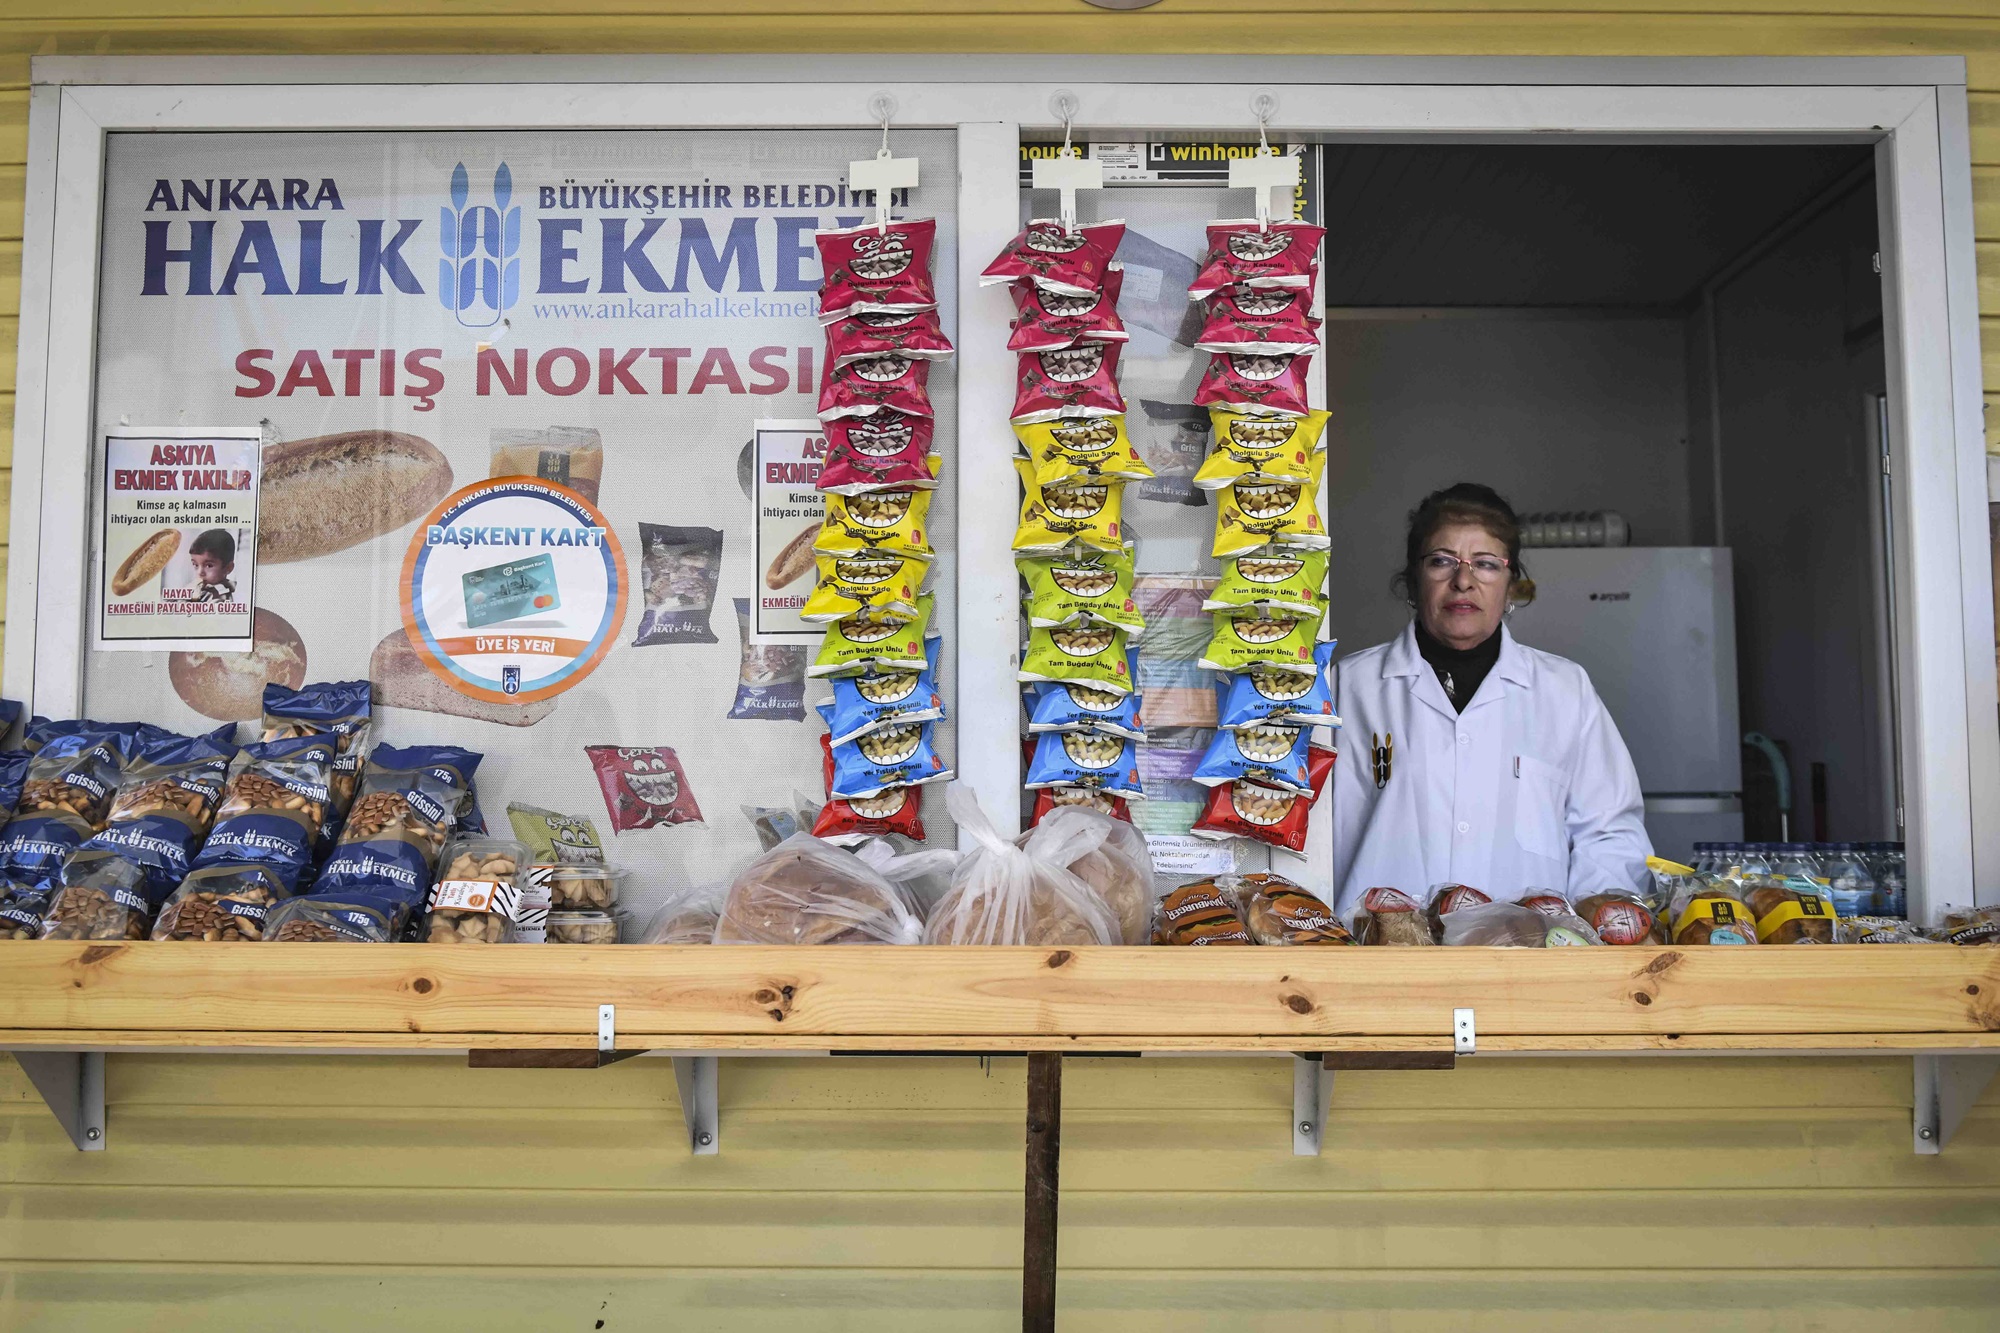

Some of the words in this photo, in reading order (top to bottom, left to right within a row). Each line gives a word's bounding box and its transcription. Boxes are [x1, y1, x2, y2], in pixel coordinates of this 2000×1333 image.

[145, 178, 345, 212] ANKARA
[538, 177, 736, 215] BÜYÜKŞEHİR
[140, 219, 426, 296] HALK
[536, 216, 904, 294] EKME
[234, 348, 445, 413] SATIŞ
[476, 346, 813, 397] NOKTASI
[150, 445, 215, 465] ASKIYA
[115, 470, 178, 490] EKMEK
[182, 470, 251, 490] TAKILIR
[442, 506, 457, 519] T.C.
[457, 489, 492, 508] ANKARA
[789, 493, 818, 503] Kimse
[137, 501, 165, 510] Kimse
[168, 503, 179, 512] aç
[183, 500, 226, 510] kalmasın
[763, 508, 800, 519] ihtiyacı
[803, 508, 824, 517] olan
[111, 514, 147, 525] ihtiyacı
[150, 515, 170, 524] olan
[174, 514, 212, 524] askıdan
[215, 514, 238, 524] alsın
[1079, 522, 1097, 530] Sade
[1247, 520, 1275, 529] Dolgulu
[428, 526, 535, 549] BAŞKENT
[541, 528, 604, 547] KART
[850, 528, 878, 536] Dolgulu
[881, 530, 900, 538] Sade
[163, 589, 193, 599] HAYAT
[108, 602, 155, 614] EKMEĞİNİ
[158, 603, 214, 617] PAYLAŞINCA
[218, 602, 248, 614] GÜZEL
[1103, 602, 1120, 610] Unlu
[476, 636, 503, 651] ÜYE
[507, 636, 519, 653] İŞ
[524, 639, 555, 653] YERİ
[837, 649, 853, 657] Tam
[856, 646, 883, 654] Buğday
[1096, 661, 1112, 671] Unlu
[862, 709, 873, 717] Yer
[875, 705, 896, 715] Fıstığı
[897, 701, 921, 711] Çeşnili
[1289, 702, 1312, 710] Çeşnili
[1101, 714, 1124, 722] Çeşnili
[94, 747, 110, 763] 175g
[306, 750, 324, 761] 175g
[434, 769, 452, 783] 175g
[876, 766, 897, 776] Fıstığı
[899, 763, 922, 772] Çeşnili
[66, 773, 105, 798] Grissini
[181, 781, 220, 804] Grissini
[285, 782, 327, 801] Grissini
[407, 791, 443, 821] Grissini
[140, 839, 184, 861] EKMEK
[208, 834, 243, 846] HALK
[255, 838, 296, 857] EKMEK
[328, 864, 360, 874] HALK
[373, 866, 417, 885] EKMEK
[1166, 895, 1229, 921] HAMBURGER
[348, 912, 370, 926] 175g
